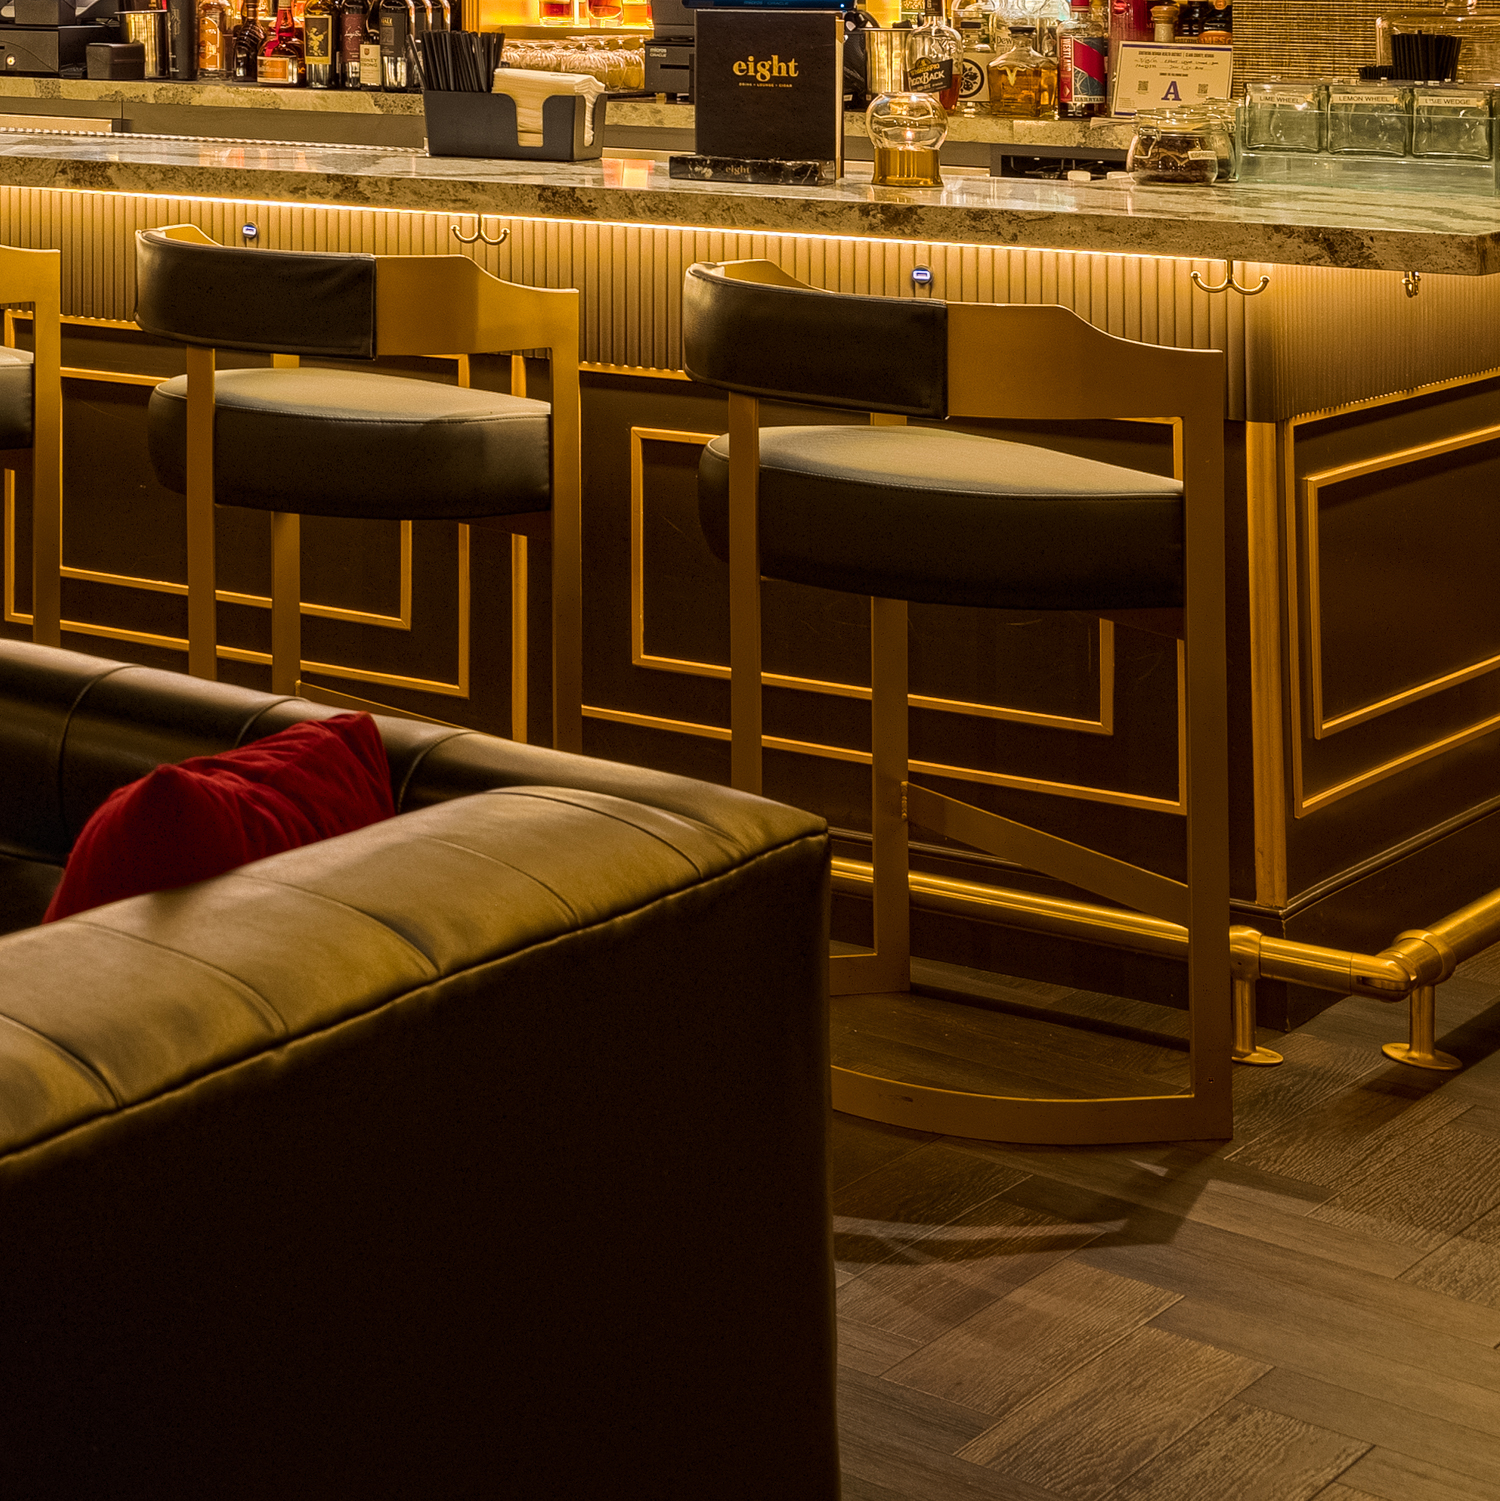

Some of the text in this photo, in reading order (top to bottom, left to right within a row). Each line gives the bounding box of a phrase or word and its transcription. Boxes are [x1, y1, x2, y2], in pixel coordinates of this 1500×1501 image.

[732, 54, 799, 82] eight
[1161, 80, 1181, 102] A
[725, 165, 750, 175] eight
